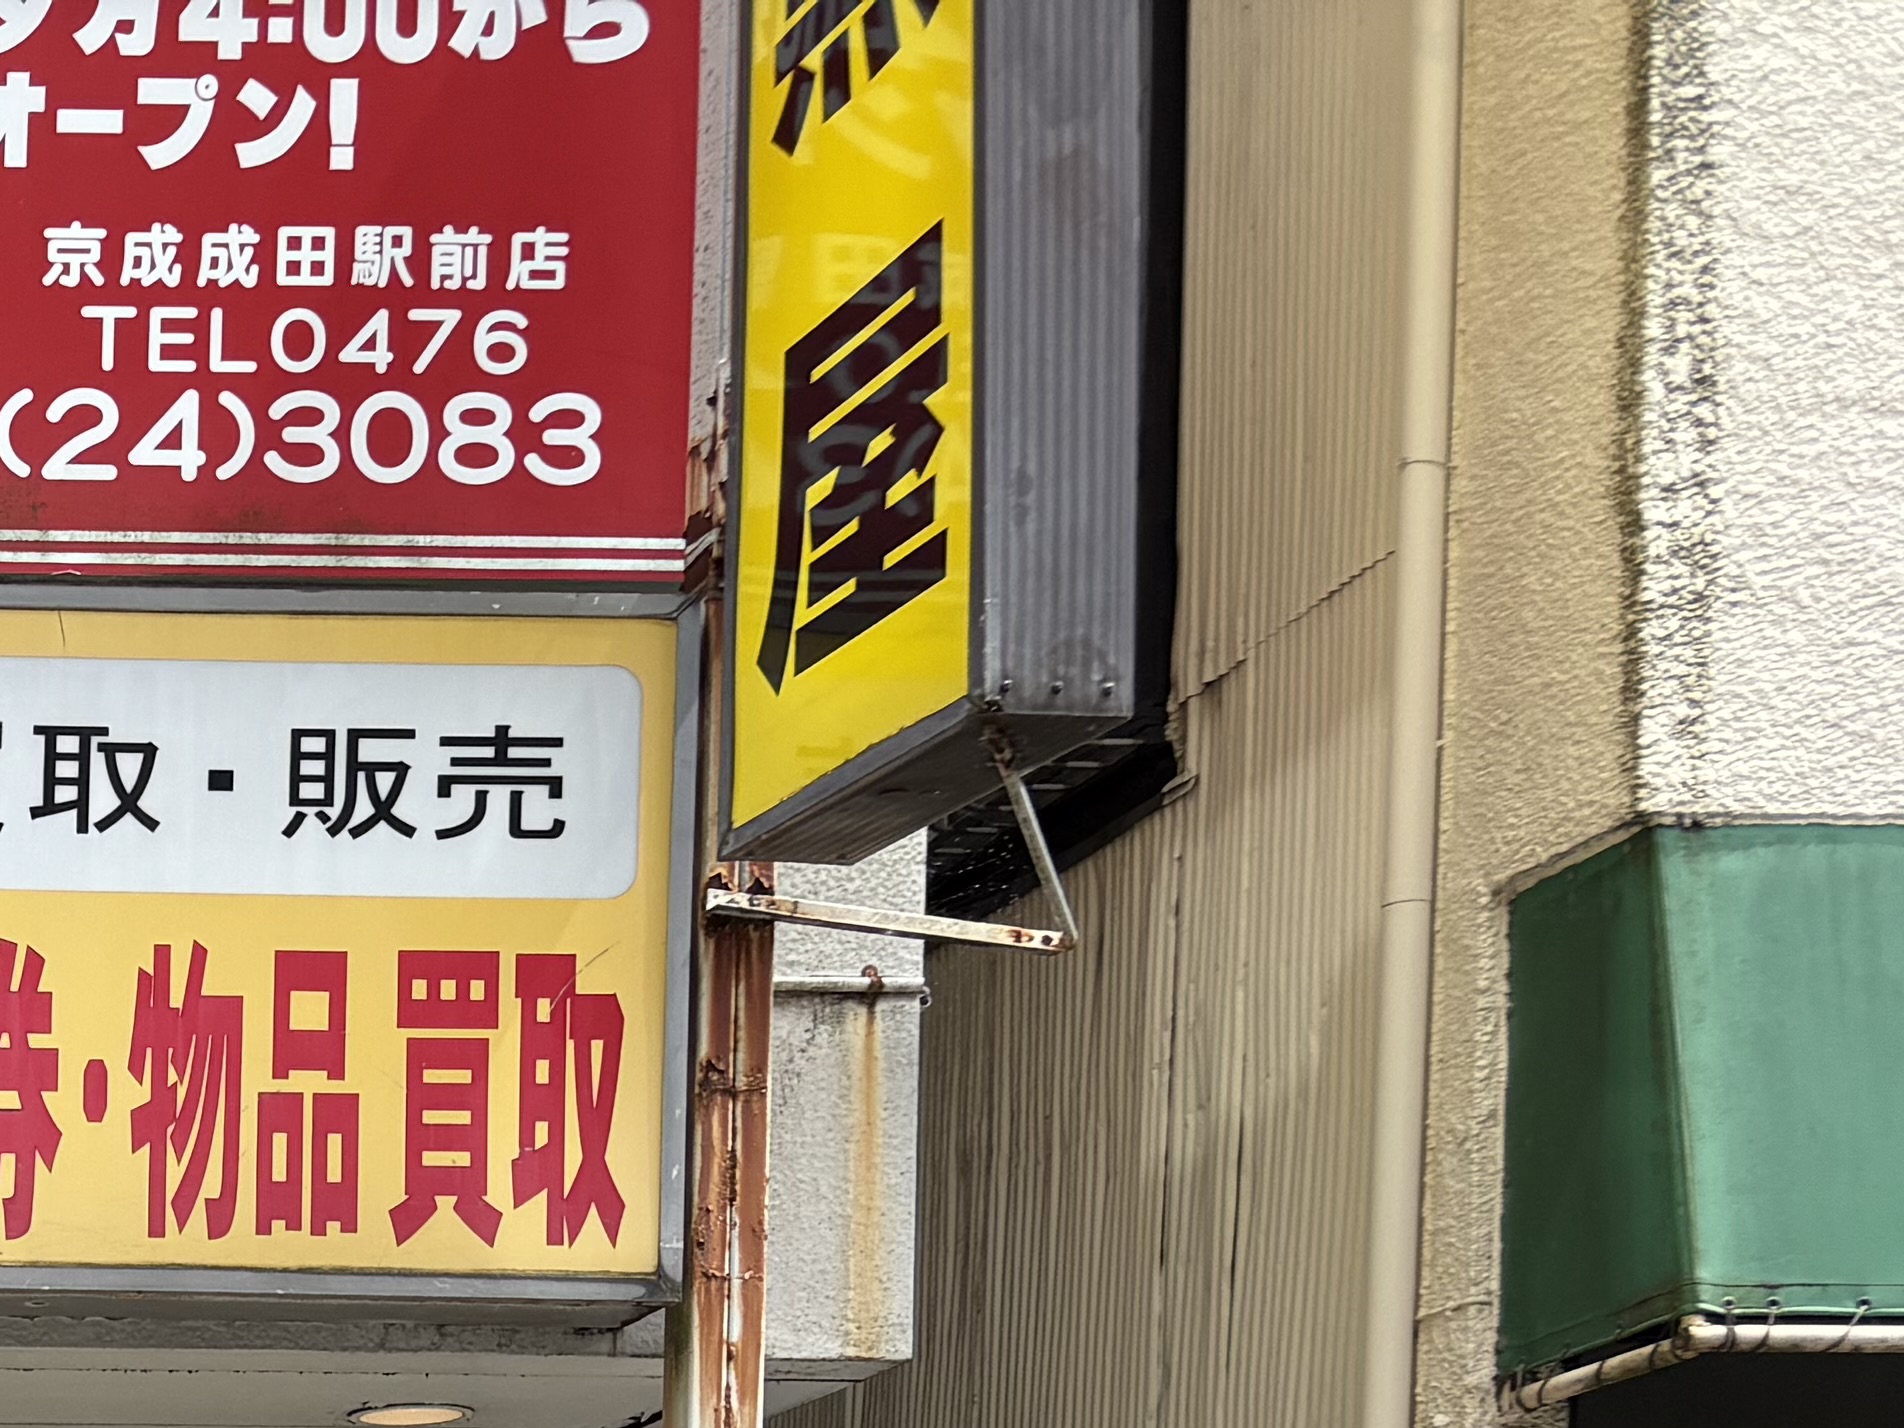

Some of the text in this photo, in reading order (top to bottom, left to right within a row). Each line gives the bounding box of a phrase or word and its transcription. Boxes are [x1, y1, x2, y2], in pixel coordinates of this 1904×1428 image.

[41, 222, 571, 290] 京成成田駅前店
[81, 307, 529, 375] TEL0476
